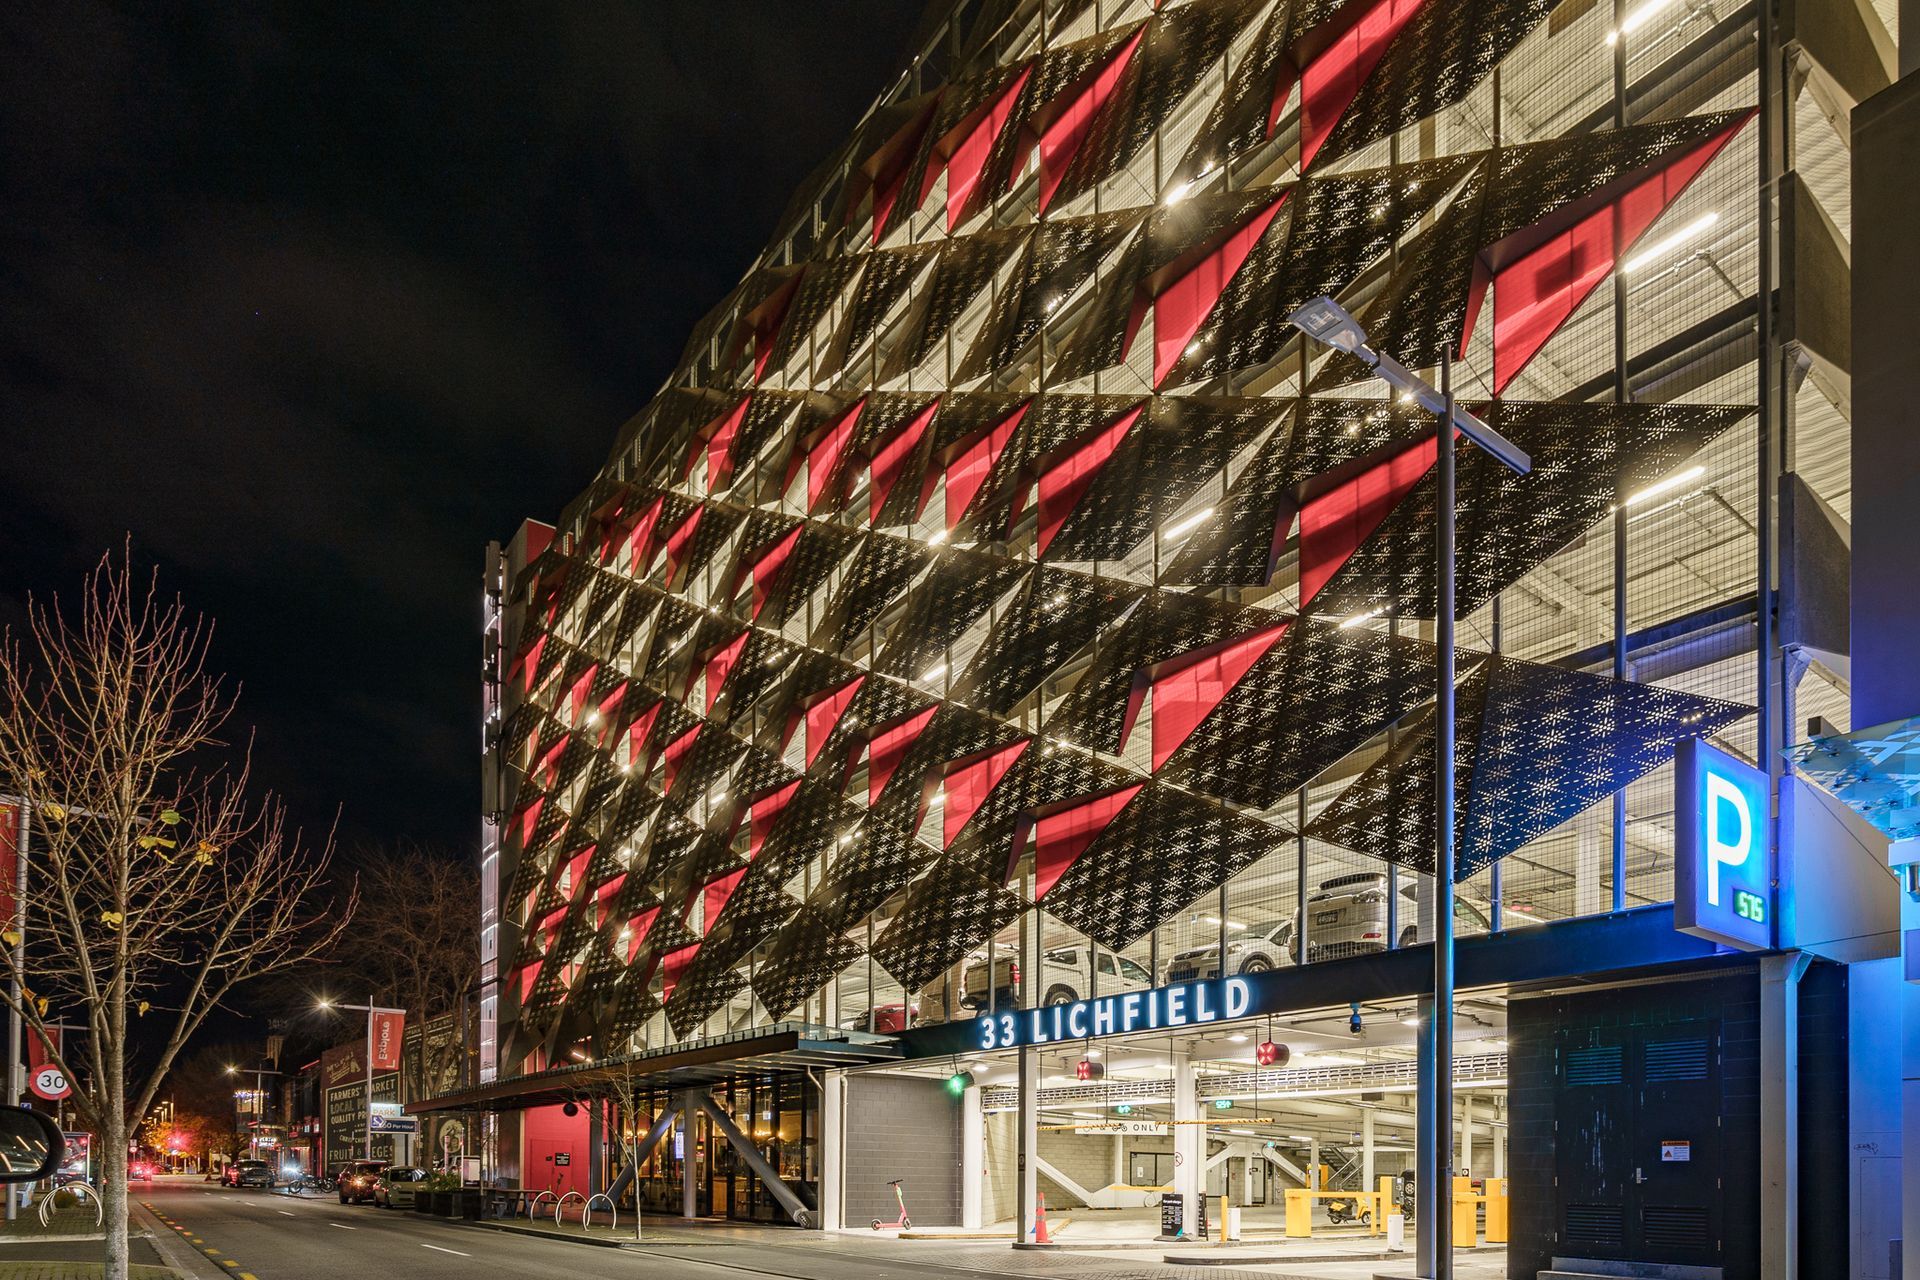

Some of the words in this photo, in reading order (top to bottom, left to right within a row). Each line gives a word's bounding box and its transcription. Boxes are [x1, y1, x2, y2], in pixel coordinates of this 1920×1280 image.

[1707, 771, 1752, 907] P
[981, 1016, 1015, 1050] 33
[1033, 979, 1250, 1043] LICHFIELD
[378, 1021, 390, 1060] Explore
[41, 1075, 65, 1088] 30
[330, 1087, 362, 1101] FARMERS'
[330, 1101, 354, 1115] LOCAL
[330, 1113, 355, 1125] QUALITY
[1133, 1124, 1160, 1132] ONLY
